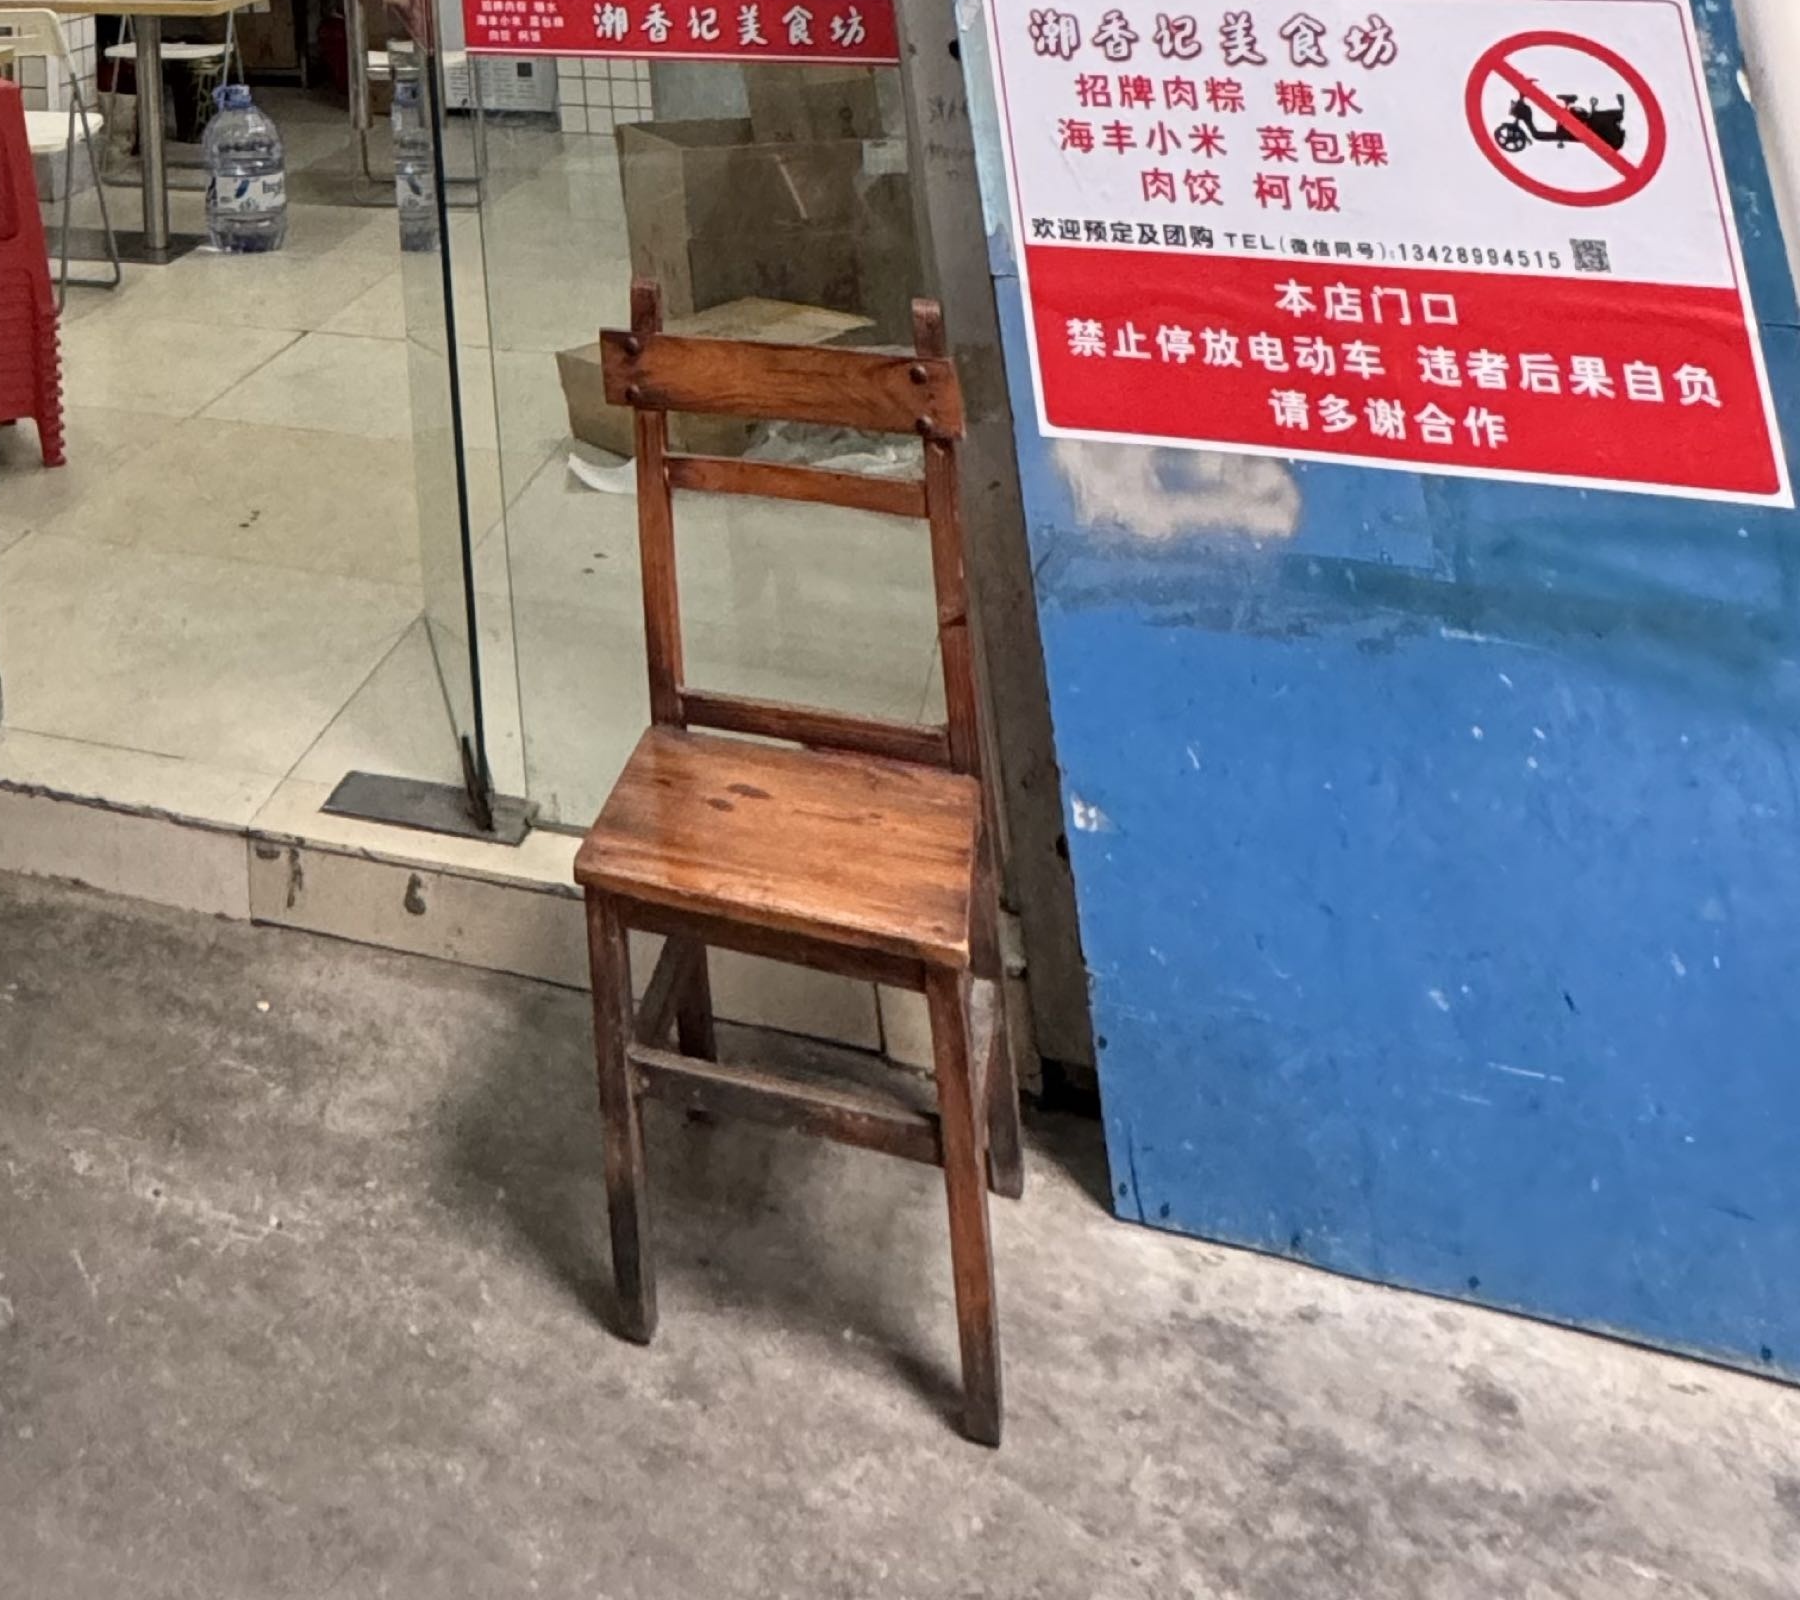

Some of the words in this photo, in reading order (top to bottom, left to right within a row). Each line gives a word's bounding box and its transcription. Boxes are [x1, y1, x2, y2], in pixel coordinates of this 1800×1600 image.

[593, 2, 868, 48] 潮香记美食坊
[1028, 8, 1399, 69] 潮香记美食坊
[1075, 74, 1247, 115] 招牌肉粽
[1274, 79, 1364, 118] 糖水
[1057, 119, 1229, 161] 海丰小米
[1255, 125, 1390, 169] 菜包粿
[1141, 168, 1224, 208] 肉饺
[1253, 173, 1342, 214] 柯饭
[1031, 217, 1216, 250] 欢迎预定及团购
[1273, 280, 1460, 328] 本店门口
[1065, 319, 1387, 381] 禁止停放电动车
[1416, 345, 1723, 408] 违者后果自负
[1267, 390, 1510, 449] 请多谢合作
